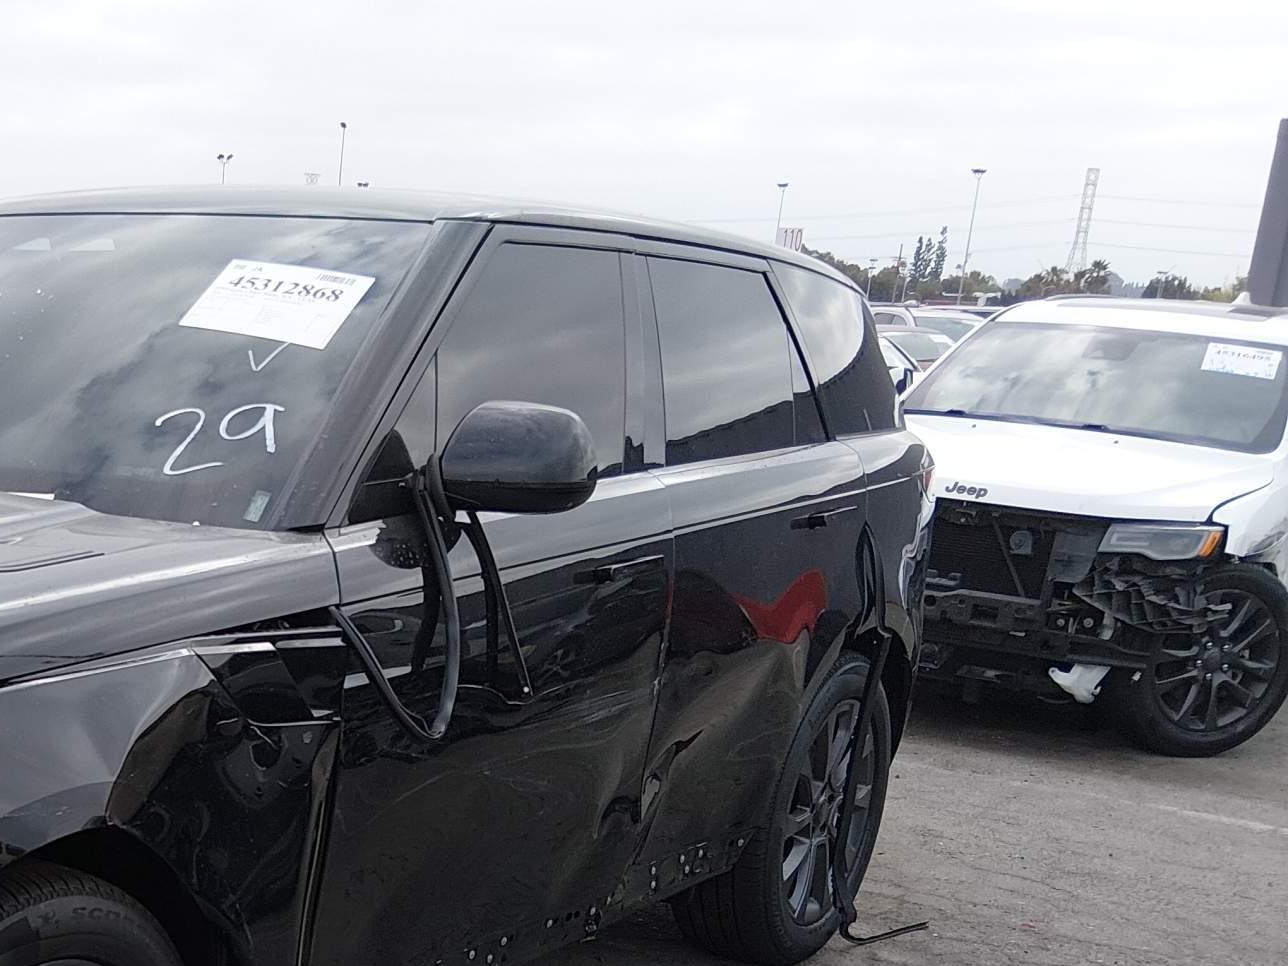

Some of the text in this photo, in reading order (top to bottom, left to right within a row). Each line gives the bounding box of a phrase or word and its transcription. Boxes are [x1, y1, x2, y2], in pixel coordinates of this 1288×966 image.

[784, 228, 803, 252] 110
[229, 275, 344, 302] 45312868
[155, 403, 285, 475] 29
[945, 481, 988, 499] Jeep
